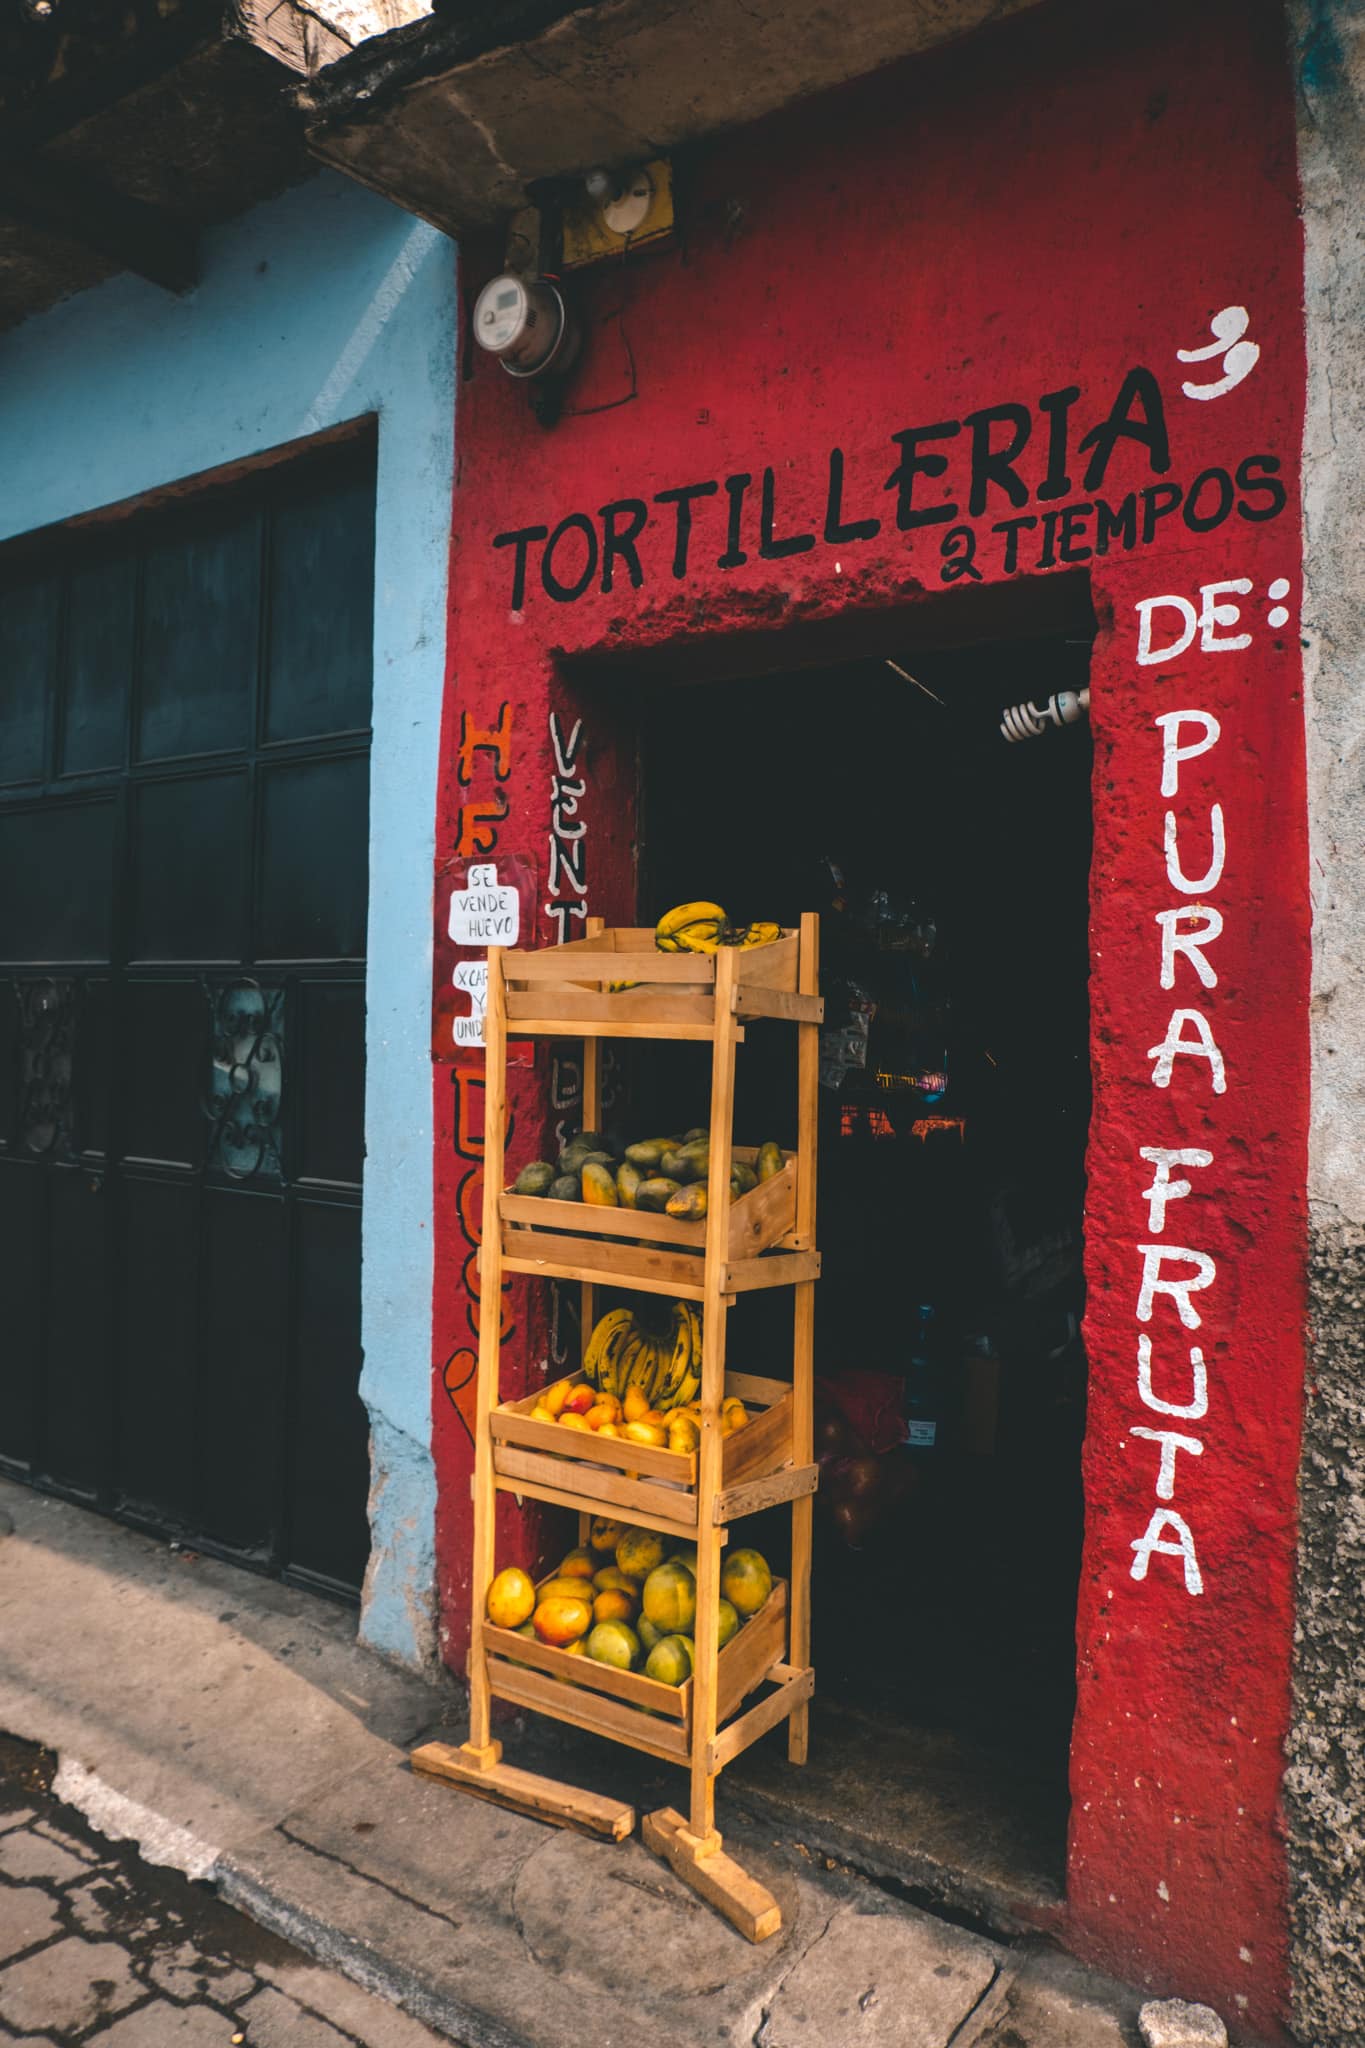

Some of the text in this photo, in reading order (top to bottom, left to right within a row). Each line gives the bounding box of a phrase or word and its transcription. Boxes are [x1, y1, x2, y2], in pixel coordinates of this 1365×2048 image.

[493, 366, 1171, 611] TORTILLERIA
[994, 454, 1288, 575] TIEMPOS
[459, 890, 508, 913] VENDE
[471, 867, 495, 888] SE
[545, 711, 588, 944] VENT
[1147, 709, 1227, 1094] PURA
[469, 915, 513, 937] HUEVO
[1129, 1146, 1216, 1597] FRUTA
